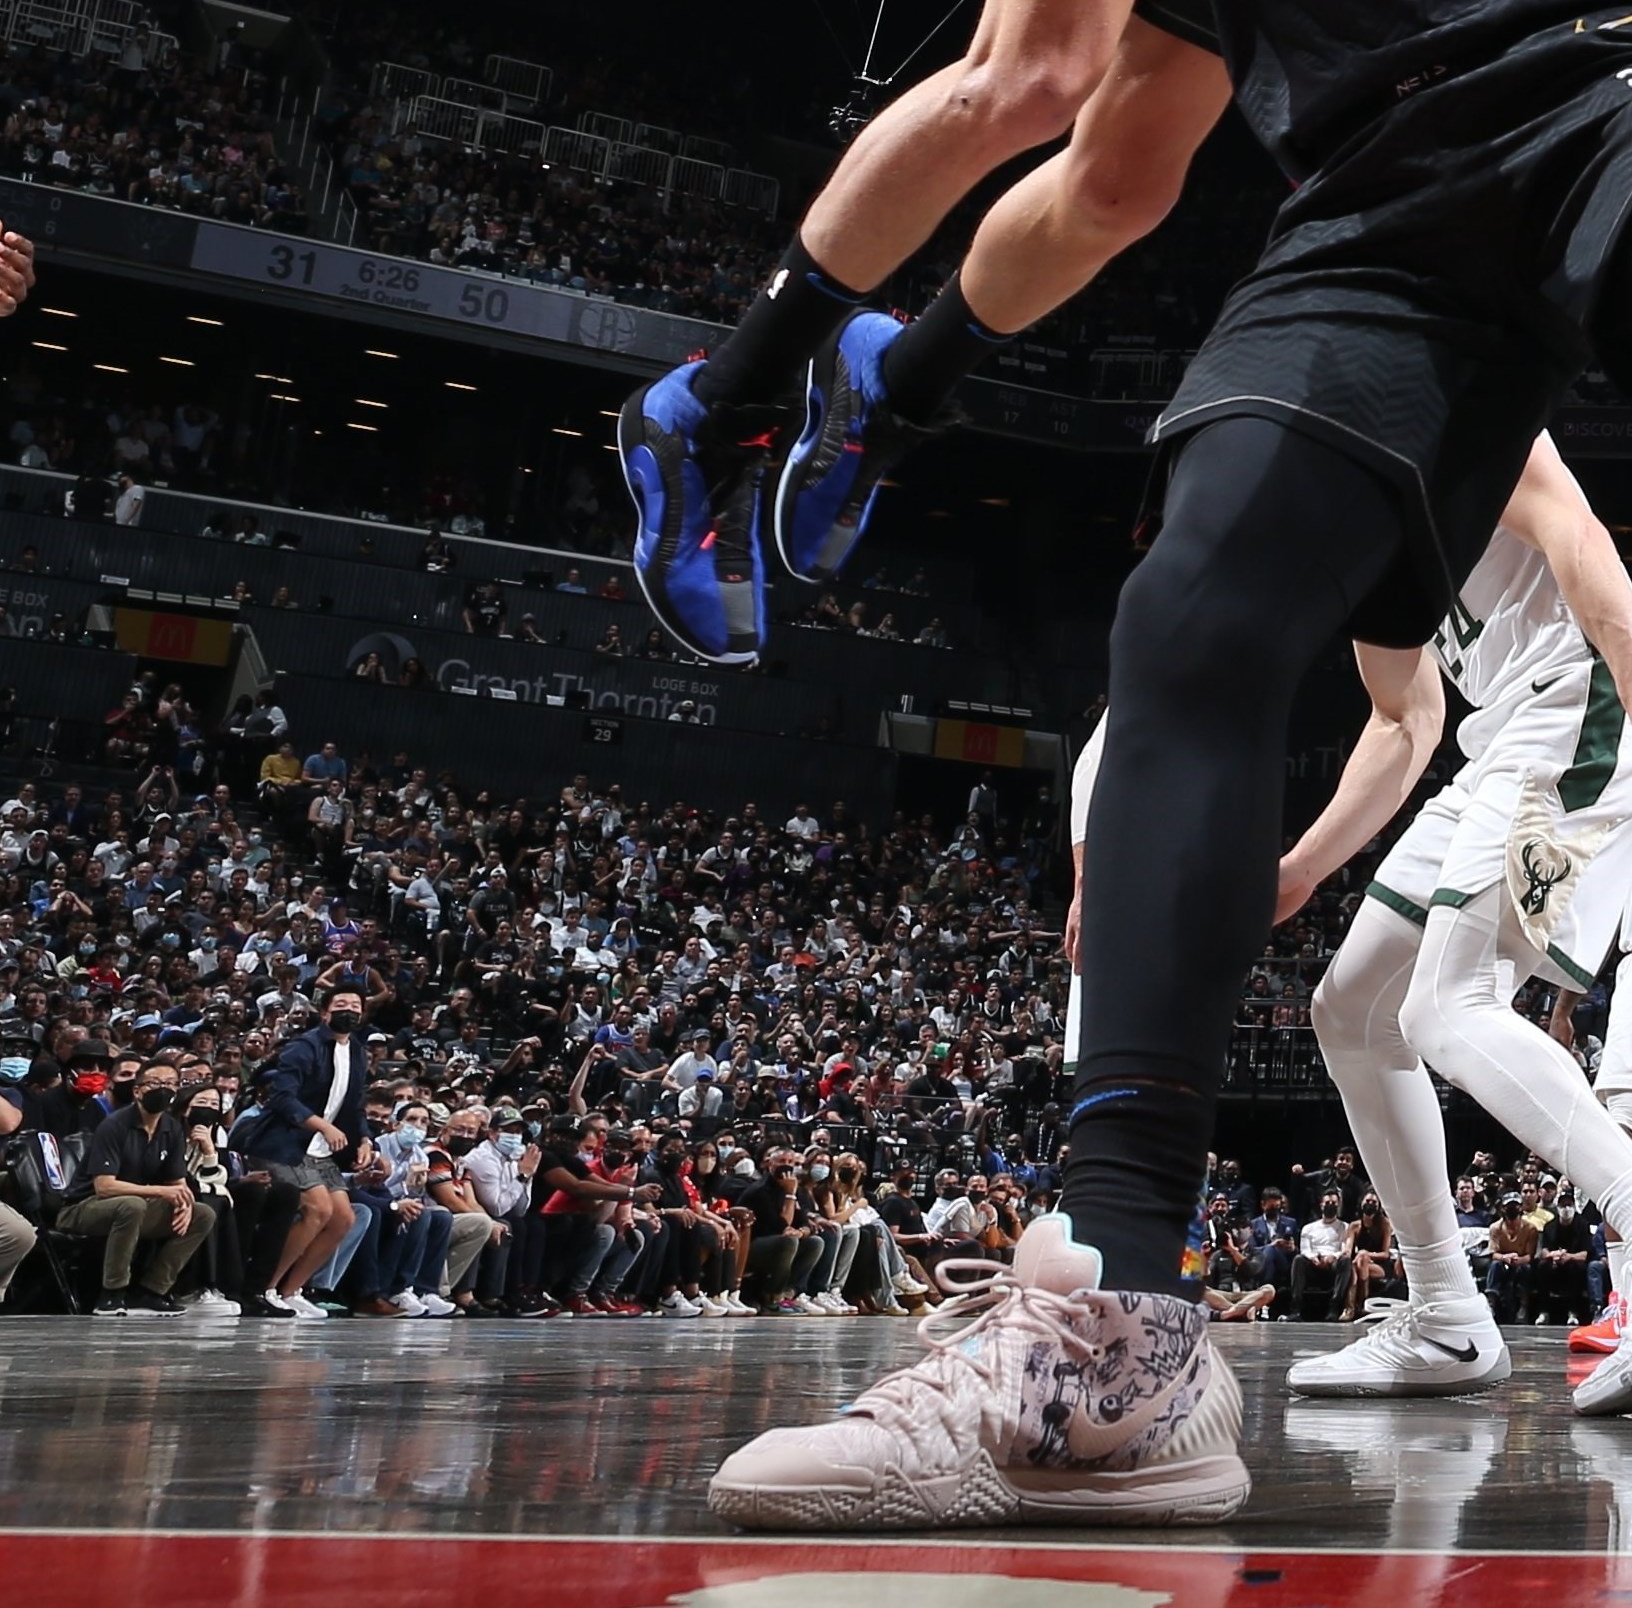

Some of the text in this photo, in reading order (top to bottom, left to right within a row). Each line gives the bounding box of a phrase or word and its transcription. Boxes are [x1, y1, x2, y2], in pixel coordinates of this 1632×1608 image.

[267, 244, 318, 285] 31
[358, 260, 421, 293] 6:26
[339, 283, 432, 313] 2nd Quarter
[458, 284, 509, 323] 50
[1003, 410, 1020, 424] 17
[1053, 420, 1070, 435] 10
[12, 590, 49, 608] BOX
[436, 658, 547, 703] Grant
[652, 676, 720, 697] LOGE BOX
[594, 729, 612, 742] 29
